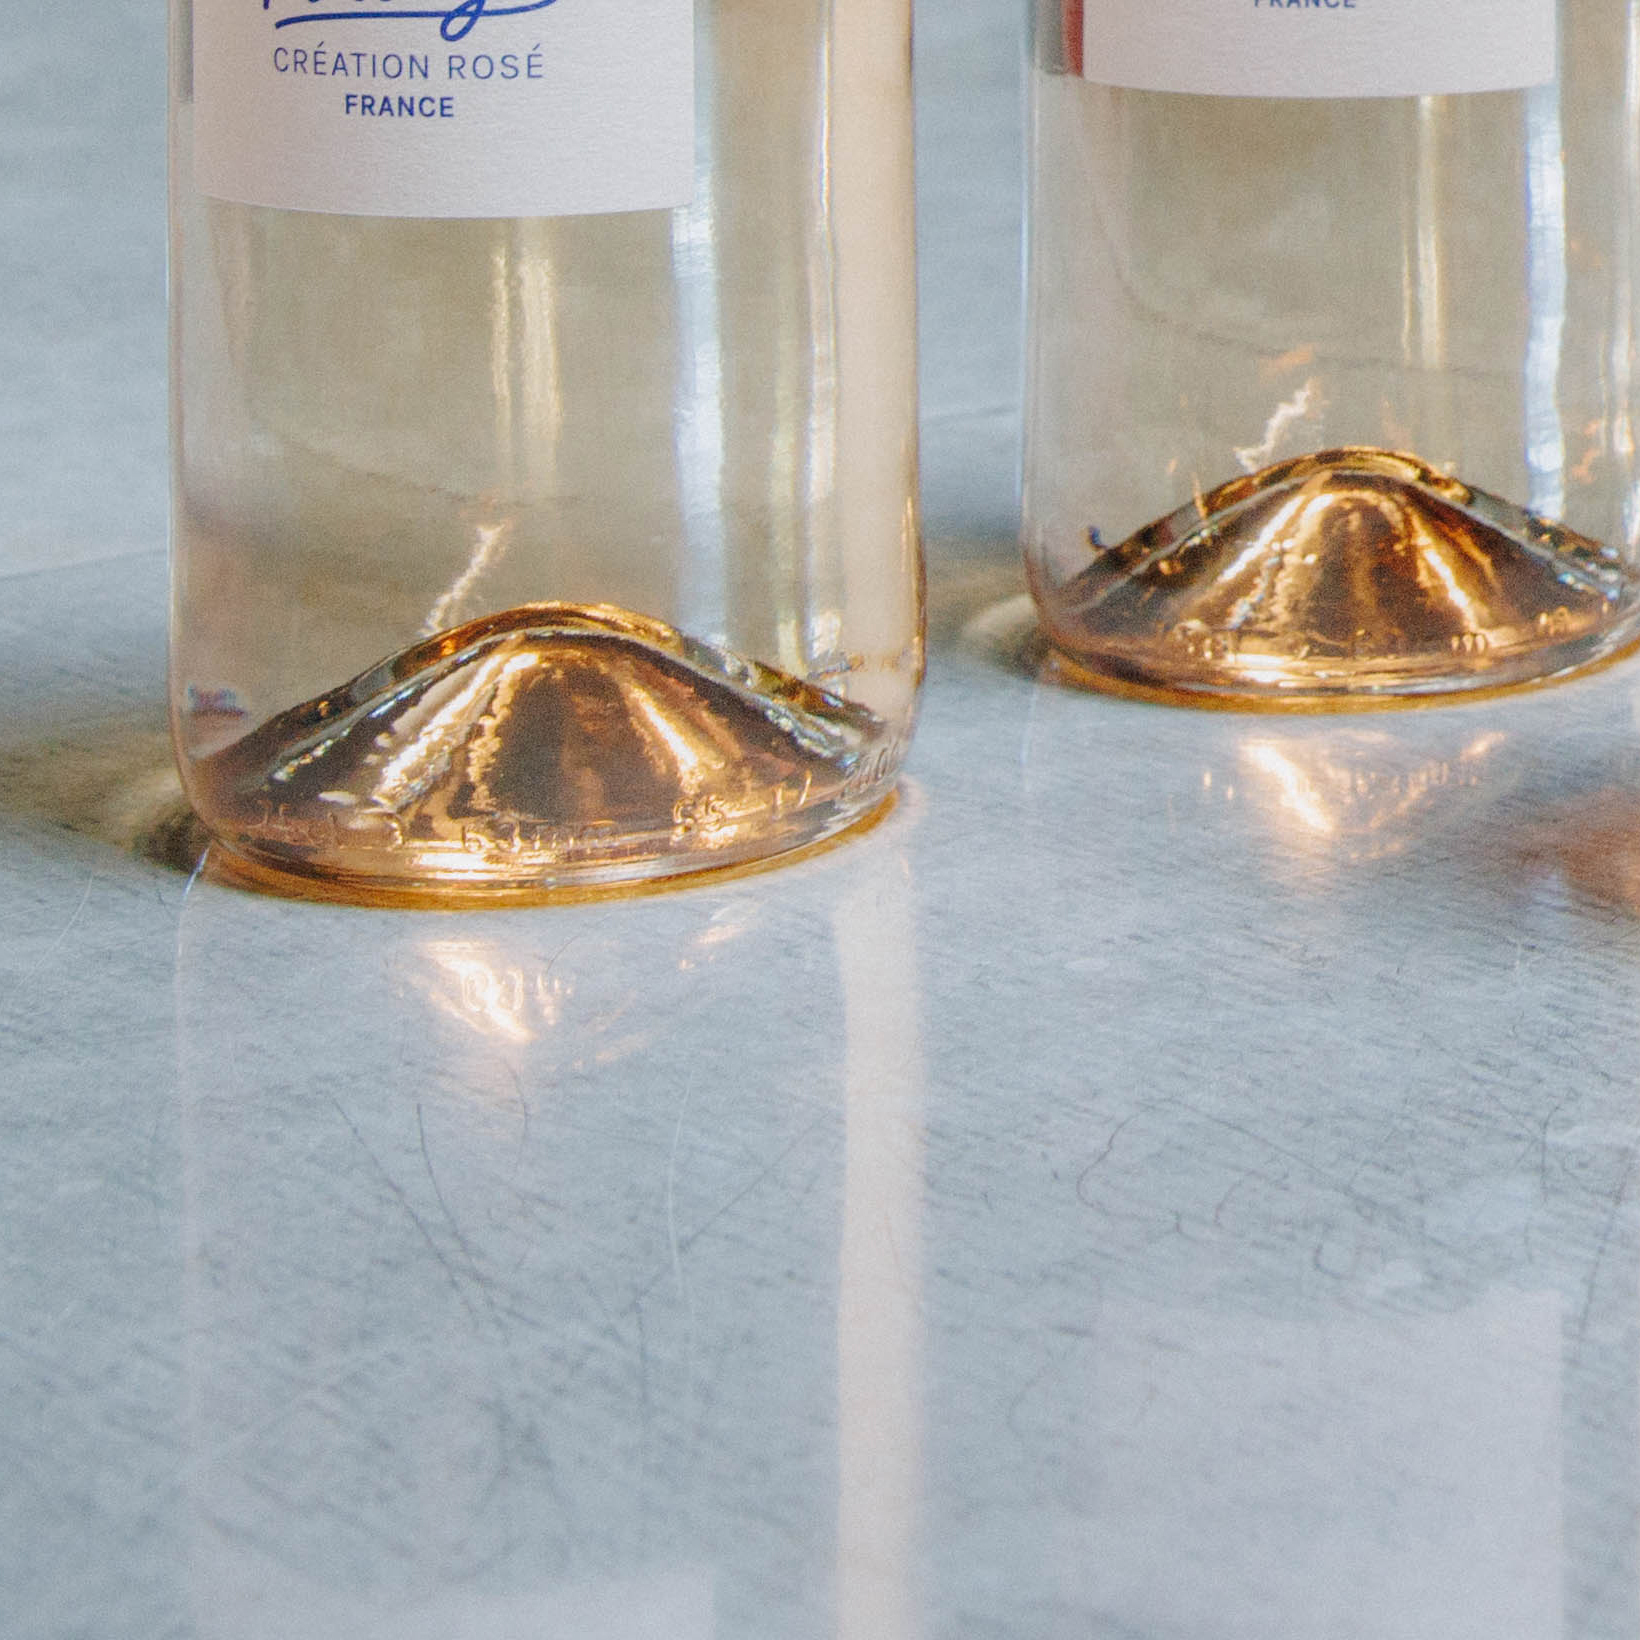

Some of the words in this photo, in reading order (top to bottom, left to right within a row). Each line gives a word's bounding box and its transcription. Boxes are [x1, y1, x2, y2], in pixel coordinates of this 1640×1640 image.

[274, 41, 429, 79] CRÉATION
[448, 43, 544, 79] ROSÉ
[345, 93, 454, 117] FRANCE
